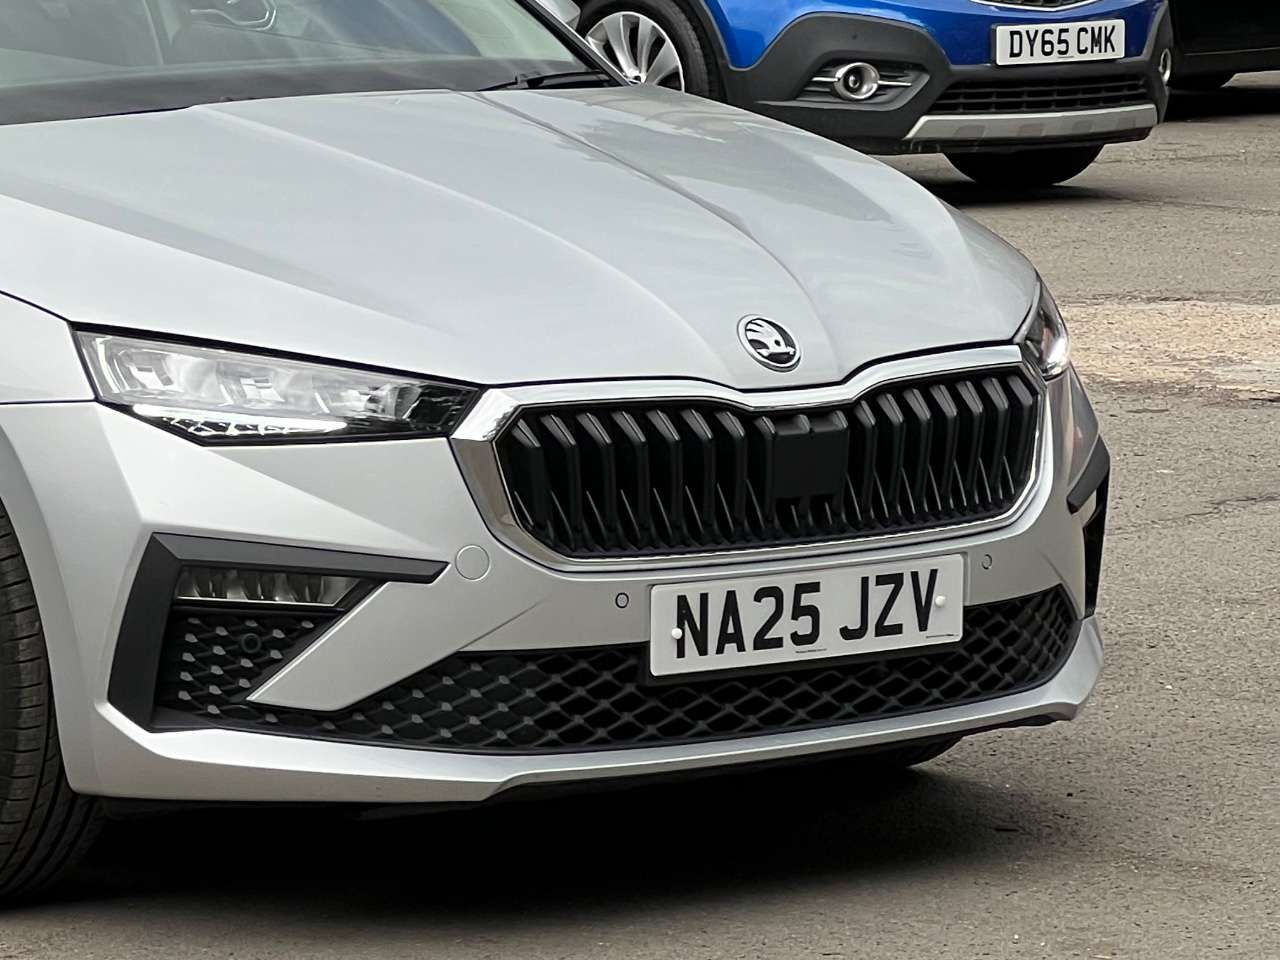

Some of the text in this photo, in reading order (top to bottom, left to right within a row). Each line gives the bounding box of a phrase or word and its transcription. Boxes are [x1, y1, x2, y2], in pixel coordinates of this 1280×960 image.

[1009, 25, 1116, 58] DY65 CMK
[675, 568, 939, 659] NA25 JZV
